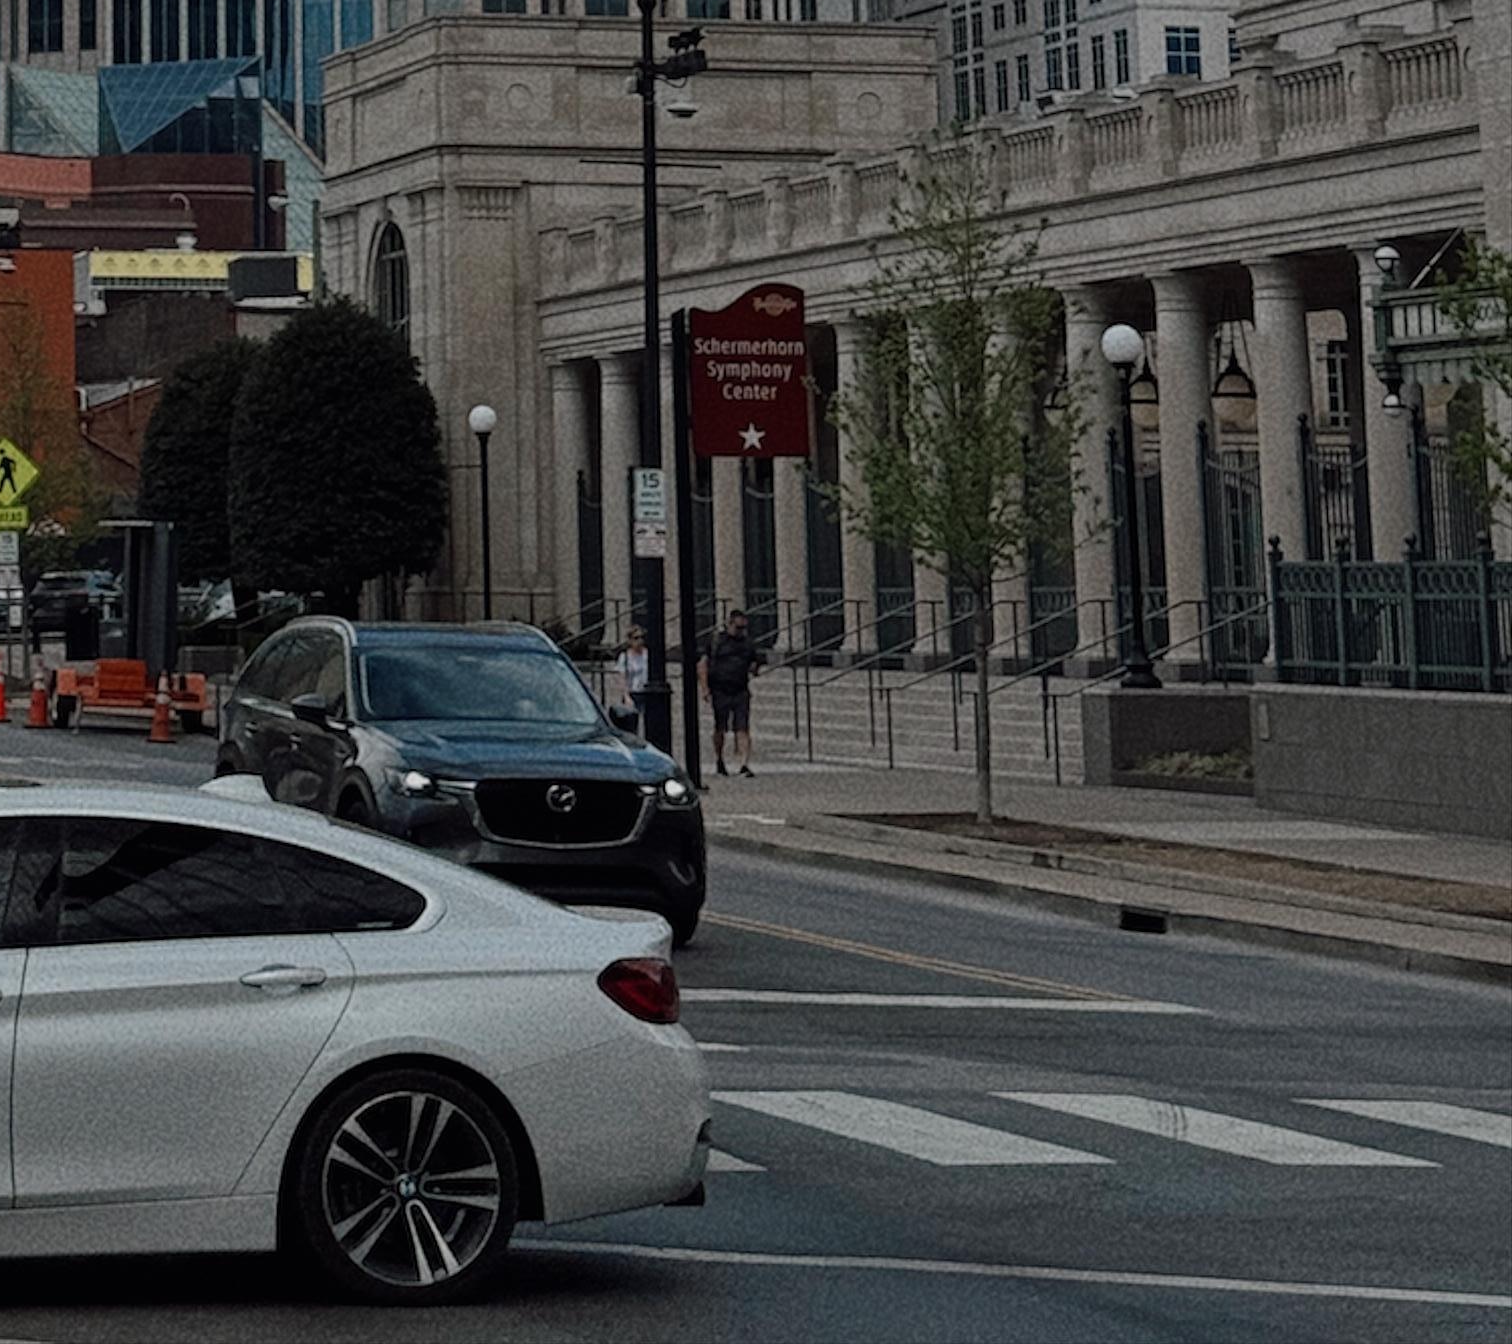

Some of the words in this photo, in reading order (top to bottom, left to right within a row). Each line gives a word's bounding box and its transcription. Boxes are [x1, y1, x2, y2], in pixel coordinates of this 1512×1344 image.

[693, 336, 805, 356] Schermerhorn
[706, 359, 794, 383] Symphony
[722, 382, 778, 401] Center
[642, 473, 660, 488] 15
